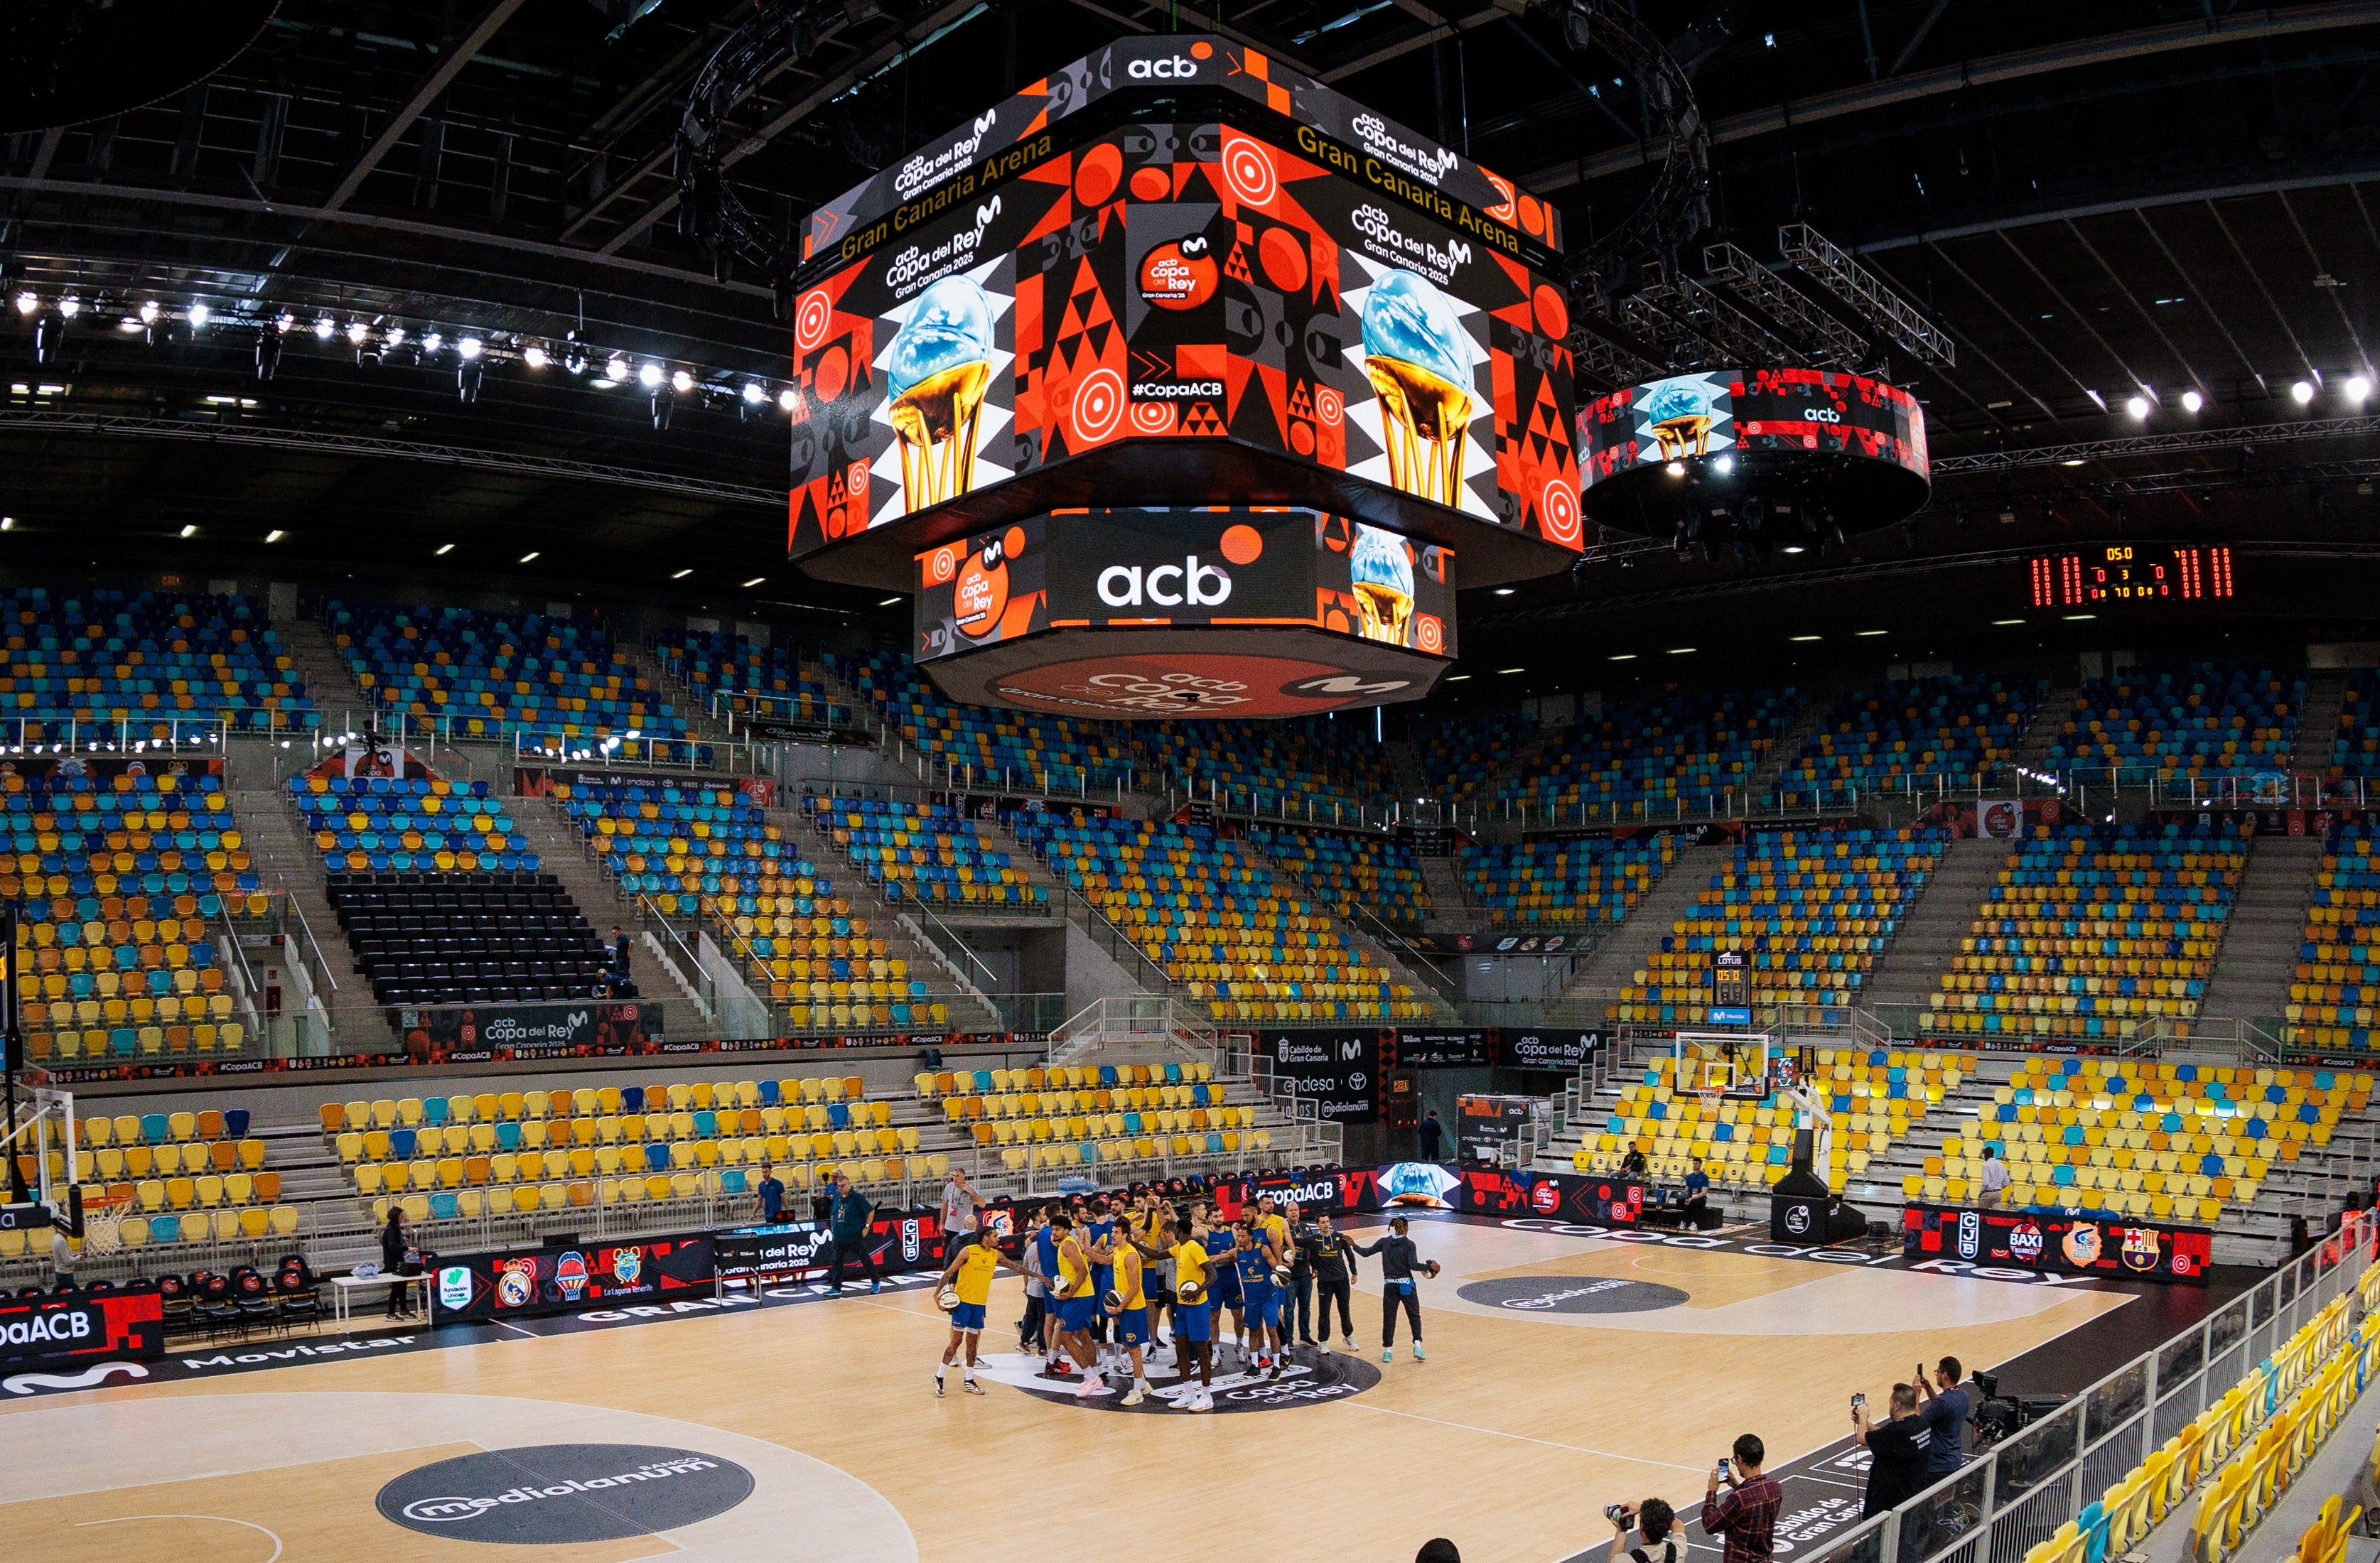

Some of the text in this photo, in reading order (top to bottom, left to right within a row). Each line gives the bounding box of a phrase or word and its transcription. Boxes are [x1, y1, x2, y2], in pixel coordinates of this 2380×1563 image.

[1128, 55, 1197, 78] acb
[1361, 113, 1385, 132] acb
[1352, 117, 1445, 179] Copa del Rey
[895, 133, 981, 192] Copa del Rey
[903, 156, 924, 175] acb
[1363, 142, 1438, 186] Gran Canaria 2025
[903, 156, 972, 201] Gran Canaria 2025
[841, 135, 1051, 261] Gran Canaria Arena
[1297, 125, 1519, 254] Gran Canaria Arena
[1362, 204, 1389, 225] acb
[1352, 209, 1458, 277] Copa del Rey
[886, 225, 984, 287] Copa del Rey
[895, 246, 918, 266] acb
[1158, 259, 1178, 267] acb
[1364, 239, 1448, 286] Gran Canaria 2025
[895, 252, 974, 299] Gran Canaria 2025
[1151, 266, 1189, 279] Copa
[1168, 278, 1196, 291] Rey
[1132, 382, 1222, 398] #CopaACB
[1805, 407, 1841, 423] acb
[966, 573, 981, 585] acb
[1097, 556, 1231, 606] acb
[962, 580, 989, 598] Copa
[974, 594, 993, 610] Rey
[1088, 673, 1252, 705] Copa
[1161, 673, 1249, 692] acb
[999, 686, 1058, 701] Gran
[494, 1017, 516, 1027] acb
[485, 1024, 574, 1042] Copa del Rey
[451, 1052, 491, 1061] #CopaACB
[1515, 1042, 1546, 1056] Copa
[1564, 1044, 1585, 1059] Rey
[221, 1062, 263, 1071] #CopaACB
[1284, 1076, 1334, 1092] endesa
[1283, 1105, 1310, 1118] OOS
[1323, 1102, 1368, 1116] mediolanum
[905, 1222, 917, 1258] CJB
[1962, 1216, 1976, 1254] CJB
[2010, 1233, 2042, 1248] BAXI
[765, 1247, 785, 1258] del
[787, 1244, 818, 1258] Rey
[1500, 1218, 2102, 1286] Copa del Rey
[789, 1258, 809, 1267] 2025
[611, 1288, 631, 1297] Laguna
[632, 1284, 653, 1293] Tenerife
[1502, 1280, 1635, 1308] mediolanum
[578, 1294, 763, 1322] GRAN
[183, 1335, 416, 1370] Movistar
[1226, 1380, 1315, 1401] Copa
[1299, 1383, 1359, 1399] Rey
[639, 1456, 701, 1473] BANCO
[404, 1459, 719, 1522] mediolanum
[1819, 1498, 1849, 1512] de
[1787, 1522, 1837, 1541] Gran
